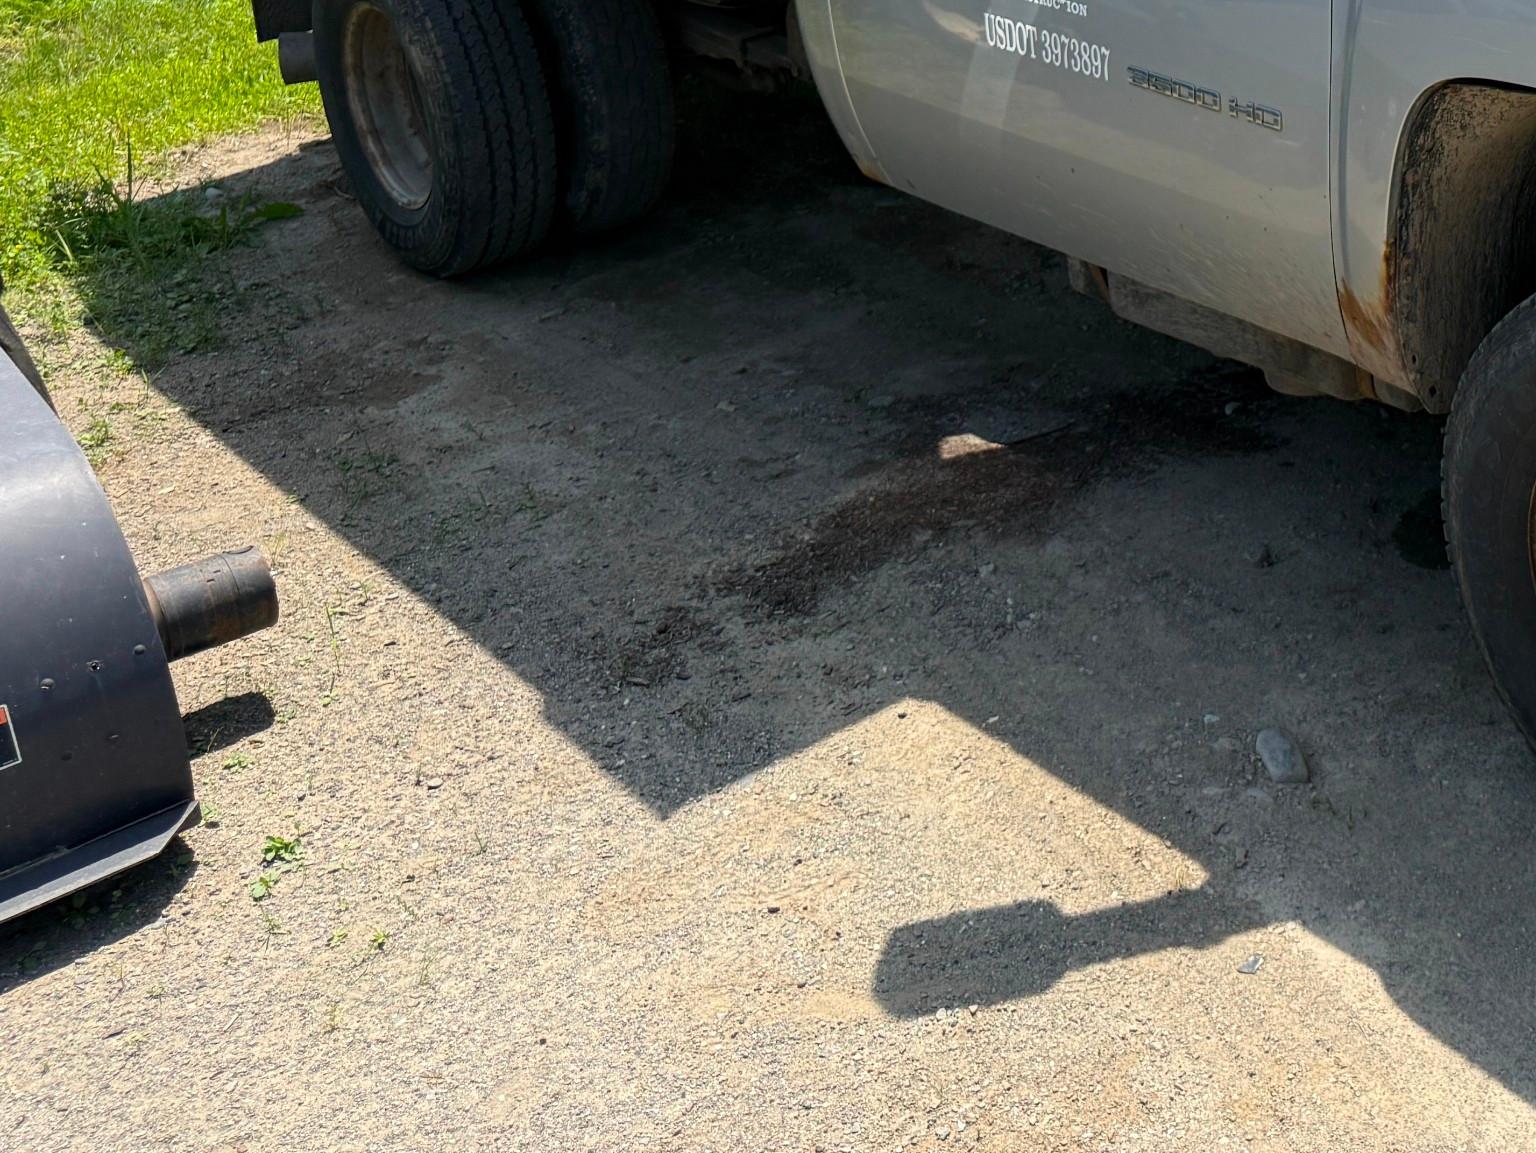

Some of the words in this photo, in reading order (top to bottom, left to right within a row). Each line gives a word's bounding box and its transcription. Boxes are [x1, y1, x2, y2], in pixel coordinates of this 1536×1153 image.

[984, 12, 1038, 59] USDOT
[1041, 30, 1110, 81] 3973897
[1127, 65, 1222, 112] 3500
[1229, 97, 1283, 132] HD
